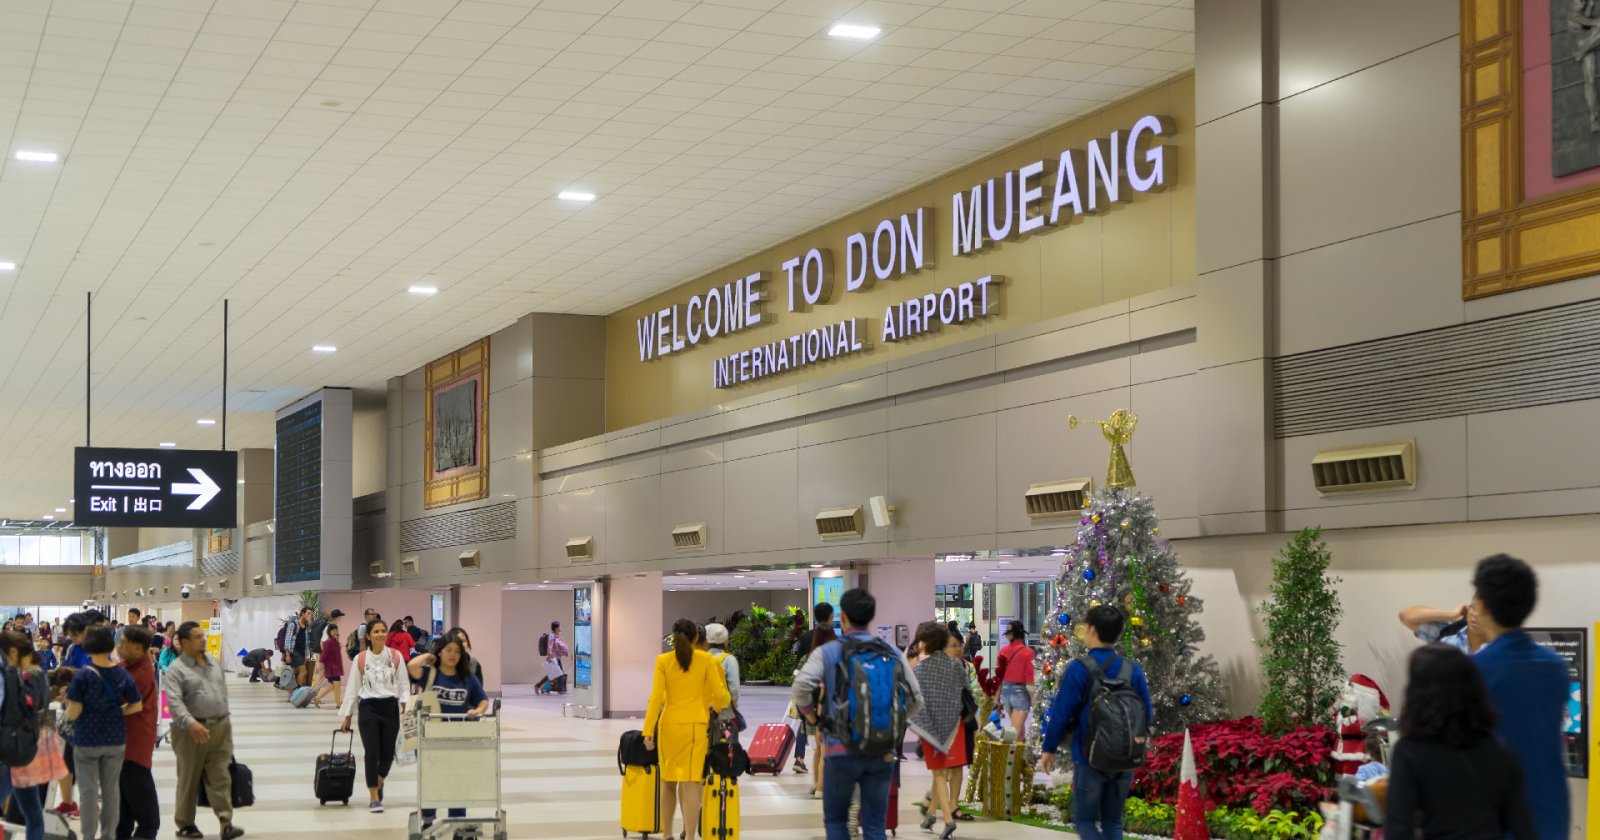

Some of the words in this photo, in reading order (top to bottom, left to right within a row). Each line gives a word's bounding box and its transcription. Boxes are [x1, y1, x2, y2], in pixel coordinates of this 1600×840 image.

[637, 271, 761, 362] WELCOME
[782, 248, 823, 313] TO
[847, 207, 923, 292] DON
[952, 115, 1163, 257] MUEANG
[713, 316, 862, 389] INTERNATIONAL
[882, 274, 992, 343] AIRPORT
[89, 460, 162, 479] ทางออก
[90, 496, 117, 512] Exit
[134, 496, 162, 513] 出口
